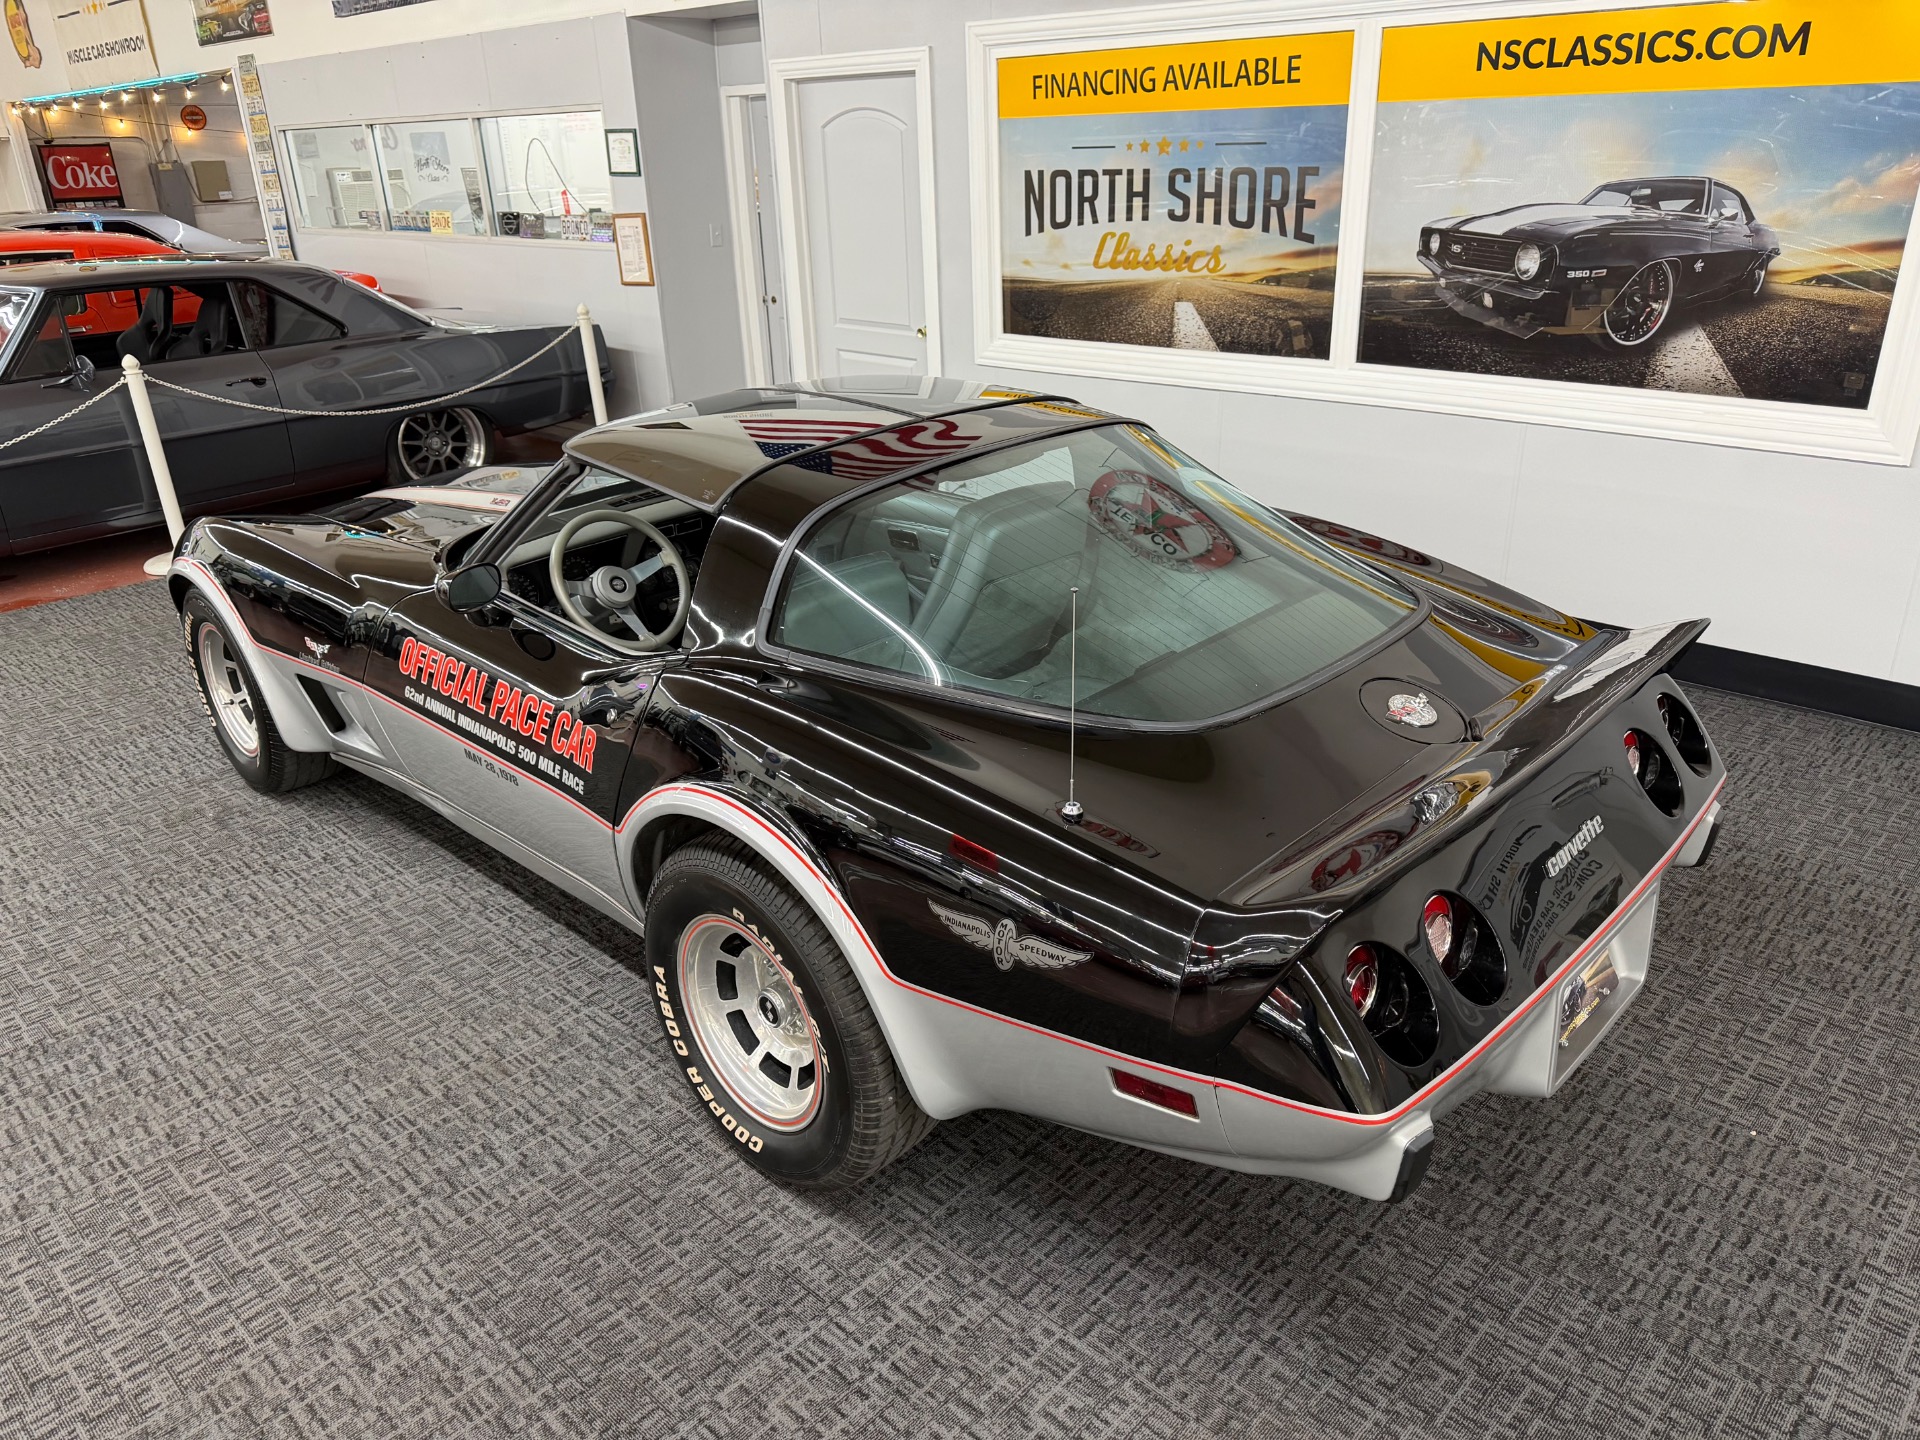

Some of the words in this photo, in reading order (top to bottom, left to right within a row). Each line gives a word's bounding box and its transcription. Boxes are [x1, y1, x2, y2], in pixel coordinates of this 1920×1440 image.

[66, 48, 92, 65] MUSCLE
[92, 43, 106, 59] CAR
[105, 34, 147, 57] SHOWROOM
[1476, 21, 1812, 72] NSCLASSICS.COM
[1032, 66, 1156, 99] FINANCING
[1162, 54, 1302, 92] AVAILABLE
[46, 155, 118, 190] Coke
[1024, 168, 1151, 236] NORTH
[1167, 166, 1320, 245] SHORE
[561, 220, 590, 236] BRONCO
[1092, 231, 1226, 273] Classics
[1567, 269, 1590, 278] 350
[186, 611, 194, 652] COBRA
[188, 655, 217, 727] COOPER
[398, 636, 488, 714] OFFICIAL
[489, 678, 555, 745] PACE
[551, 710, 597, 774] CAR
[404, 685, 424, 706] 62nd
[425, 695, 457, 725] ANNUAL
[457, 712, 516, 755] INDIANAPOLIS
[518, 746, 536, 766] 500
[538, 756, 561, 779] MILE
[562, 769, 585, 795] RACE
[463, 748, 483, 766] MAY
[944, 914, 991, 939] INDIANAPOLIS
[995, 922, 1008, 966] MOTOR
[1019, 943, 1067, 963] SPEEDWAY
[653, 965, 689, 1057] COBRA
[687, 1066, 763, 1153] COOPER
